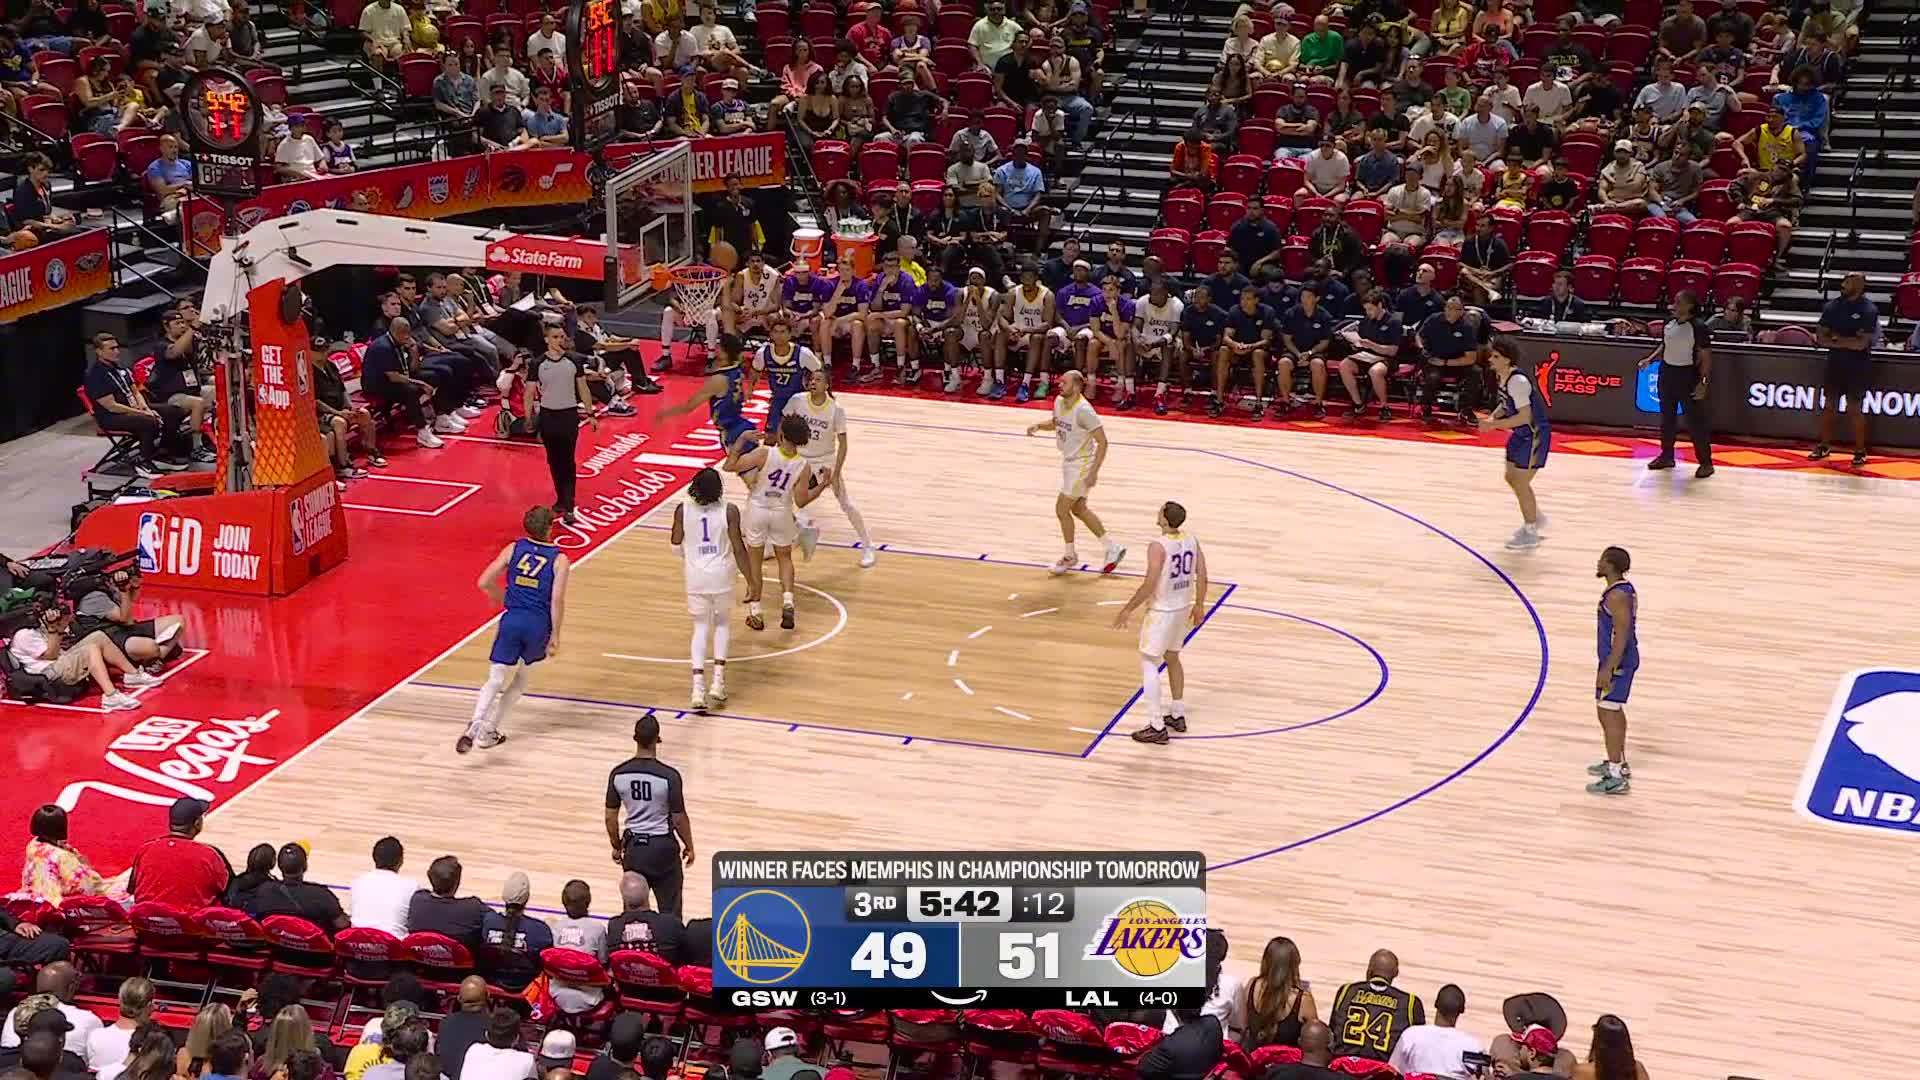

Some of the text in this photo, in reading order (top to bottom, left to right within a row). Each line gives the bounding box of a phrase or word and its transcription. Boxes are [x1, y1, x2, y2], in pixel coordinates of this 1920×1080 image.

[211, 154, 254, 166] TISSOT
[718, 145, 773, 177] LEAGUE
[261, 344, 283, 364] GET
[261, 364, 284, 385] THE
[775, 373, 791, 386] 27
[1554, 374, 1622, 387] LEAGUE
[269, 385, 290, 410] App
[1554, 383, 1596, 394] PASS
[1749, 383, 1815, 410] SIGN
[768, 468, 791, 490] 41
[303, 480, 336, 521] SUMMER
[553, 467, 676, 550] Michelob
[213, 523, 251, 552] JOIN
[305, 508, 333, 548] LEAGUE
[700, 516, 711, 542] 1
[212, 551, 261, 581] TODAY
[516, 552, 548, 577] 47
[1170, 550, 1194, 579] 30
[106, 715, 203, 752] LAS
[631, 780, 653, 802] 80
[1832, 786, 1920, 826] NB
[1343, 1005, 1393, 1052] 24
